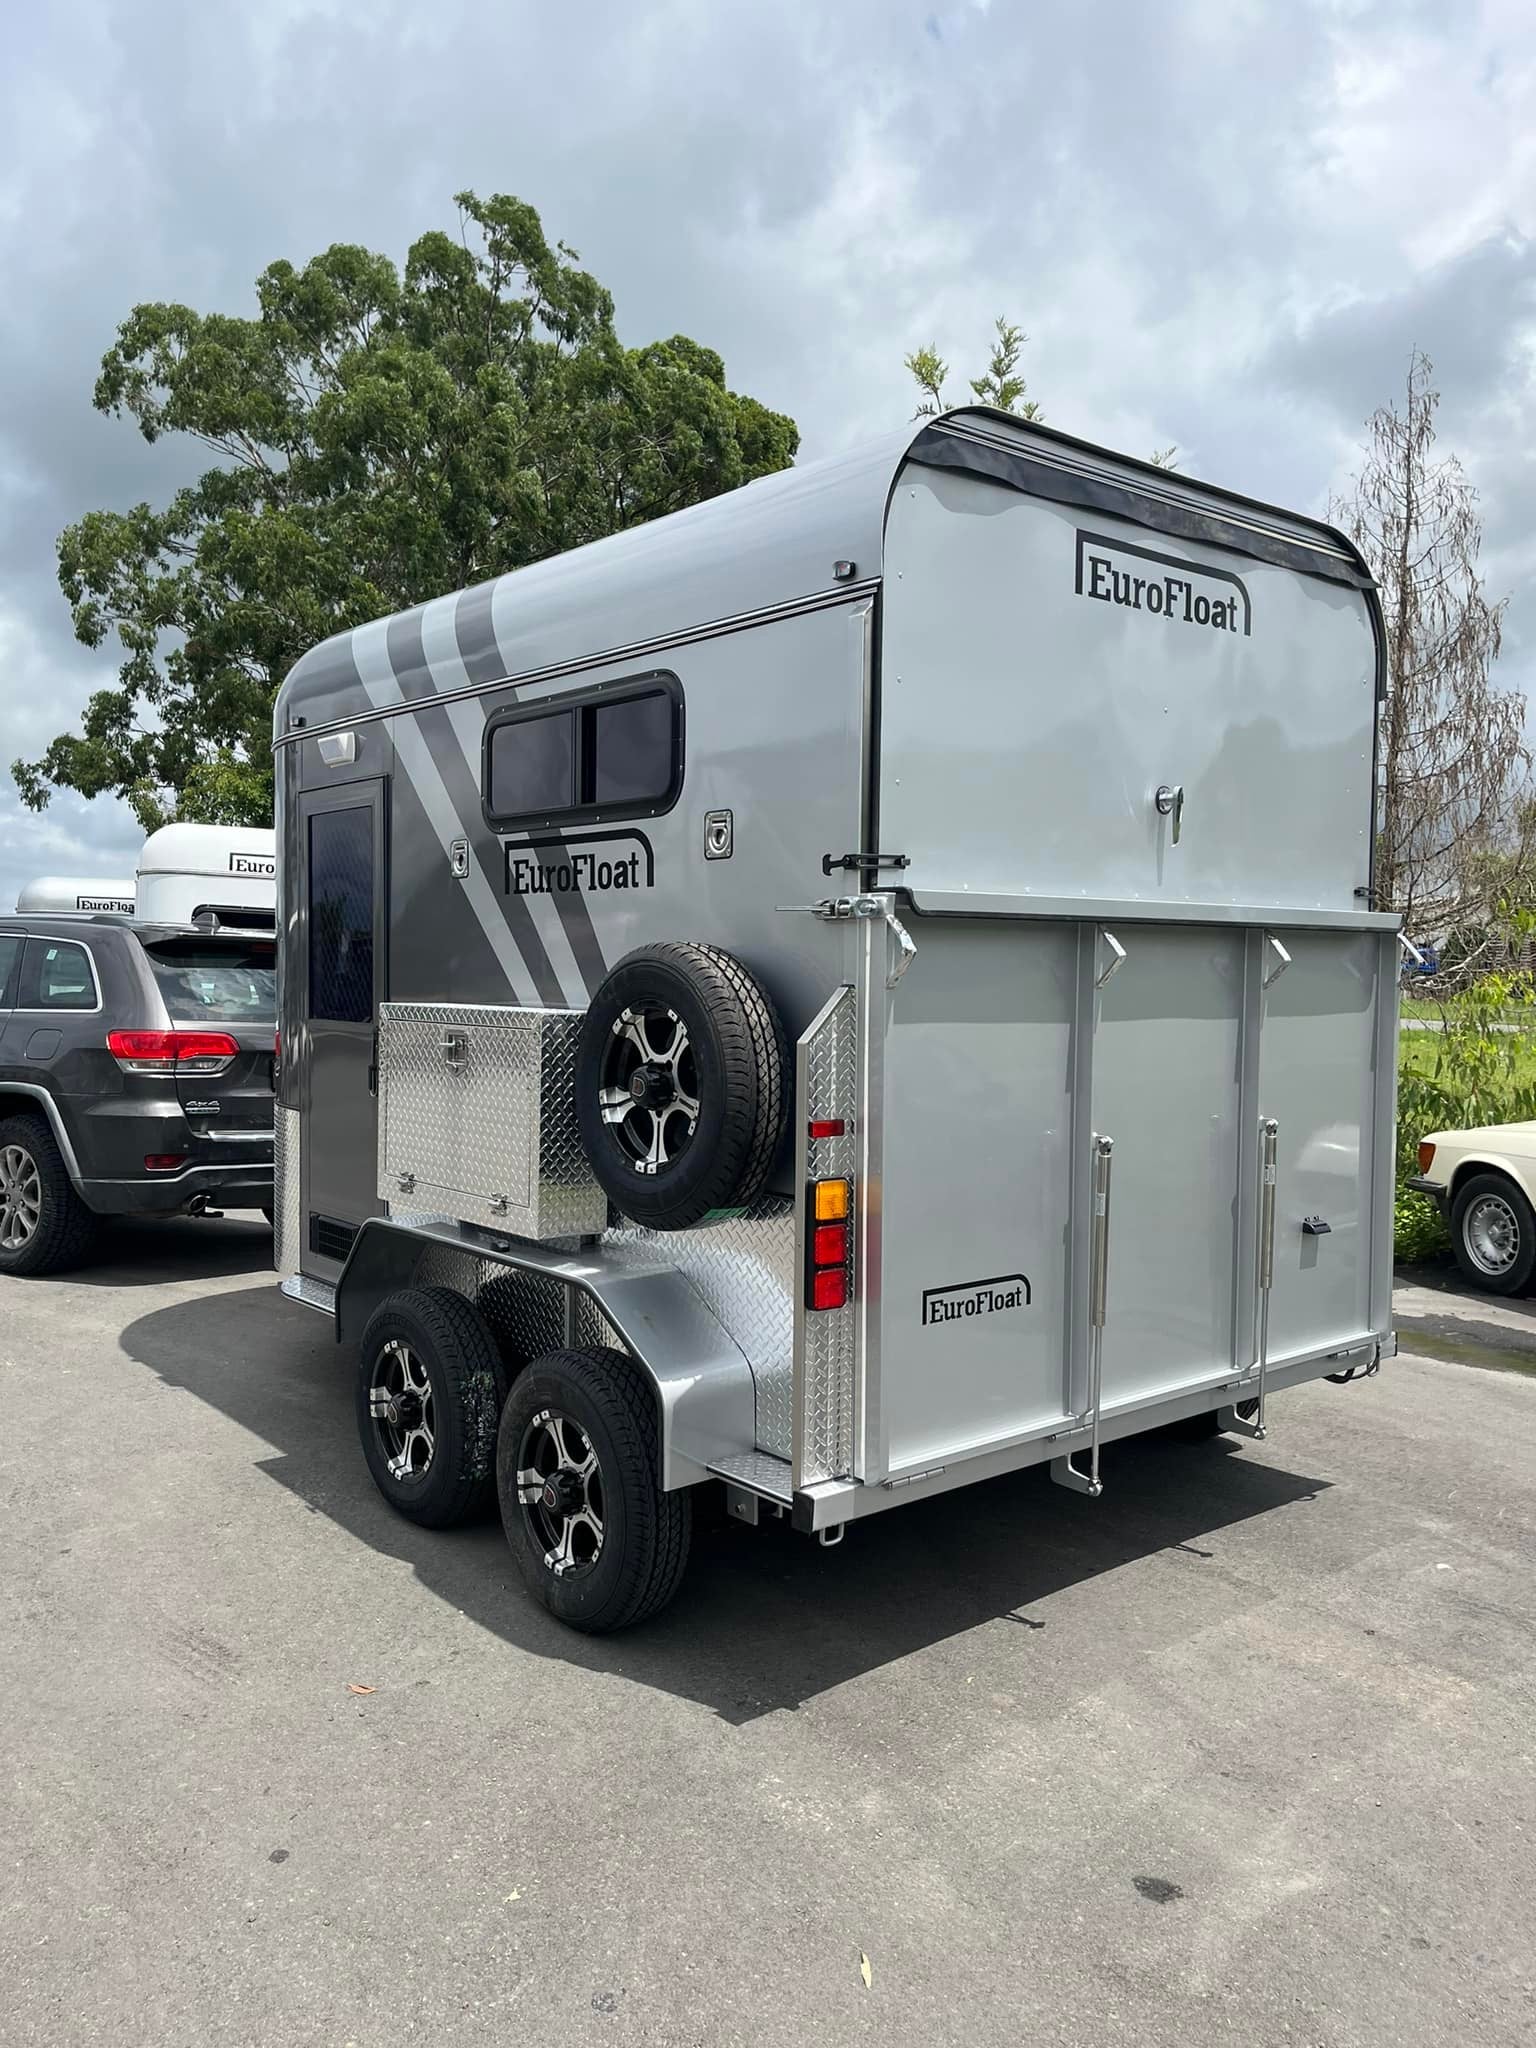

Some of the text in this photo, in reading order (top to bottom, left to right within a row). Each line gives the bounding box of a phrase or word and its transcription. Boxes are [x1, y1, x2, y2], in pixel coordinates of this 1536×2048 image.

[1088, 556, 1237, 632] EuroFloat
[236, 859, 275, 873] Euro
[513, 852, 639, 894] EuroFloat
[929, 1286, 1022, 1324] EuroFloat
